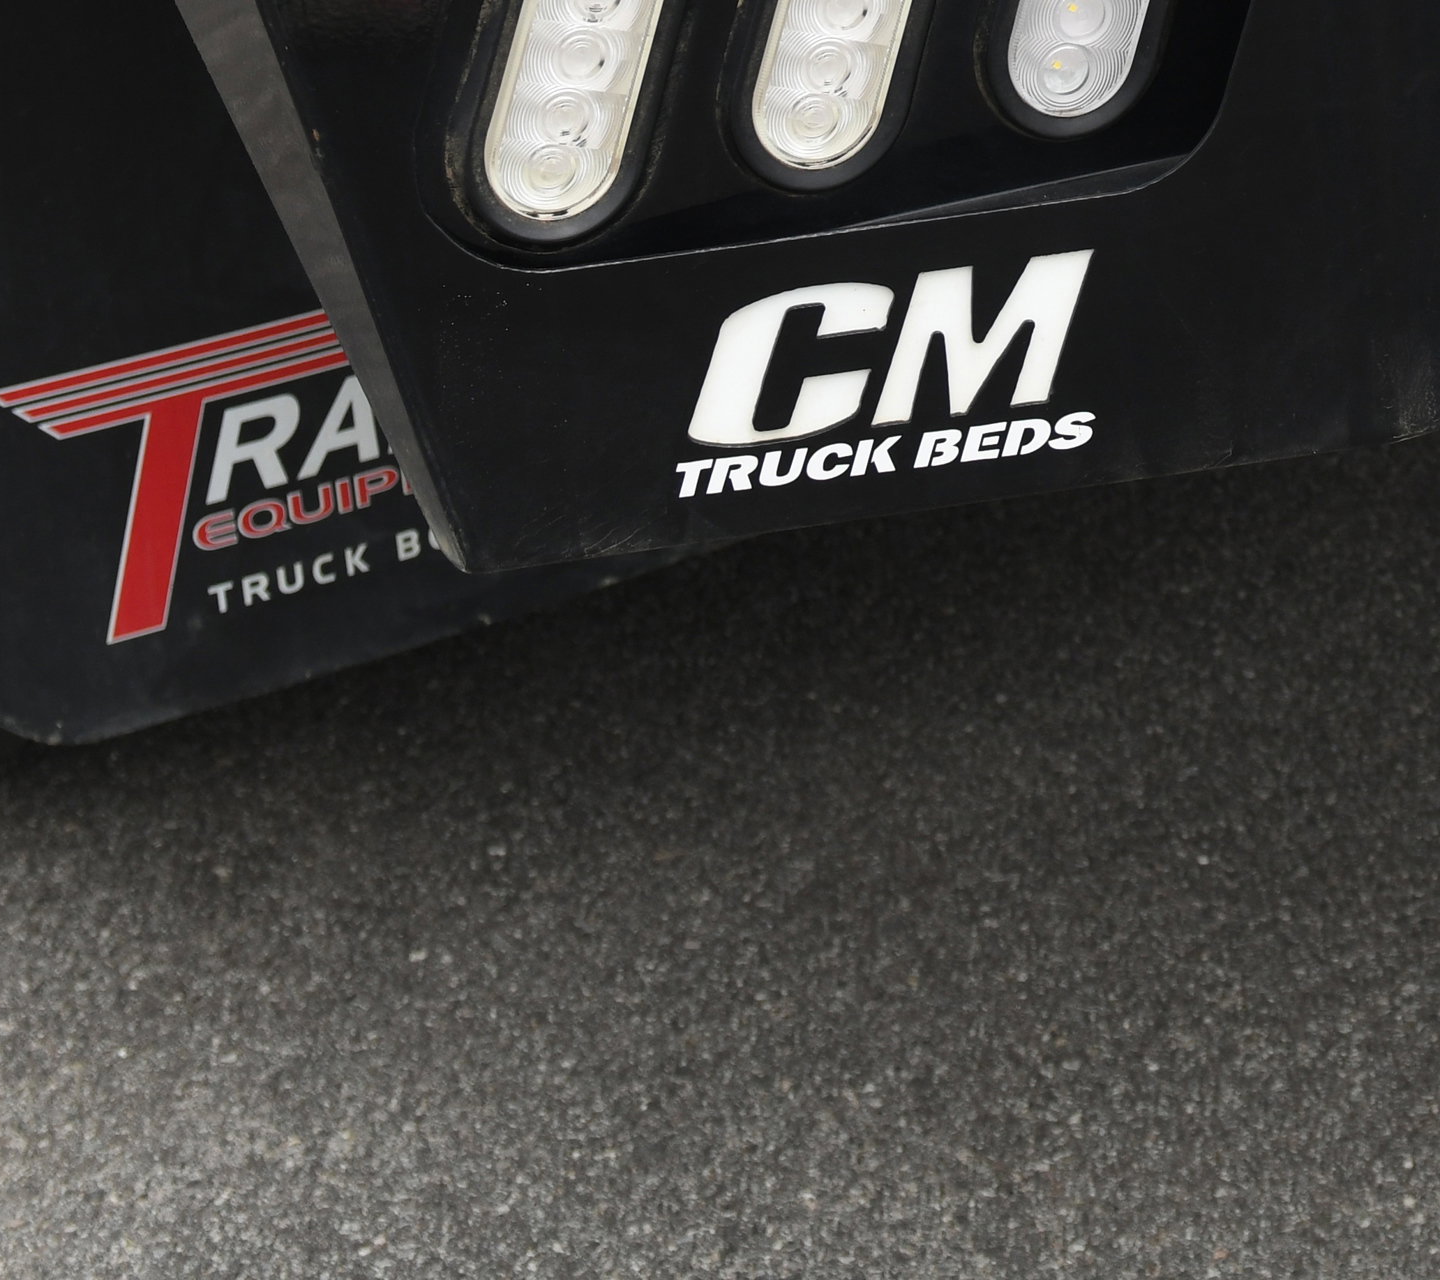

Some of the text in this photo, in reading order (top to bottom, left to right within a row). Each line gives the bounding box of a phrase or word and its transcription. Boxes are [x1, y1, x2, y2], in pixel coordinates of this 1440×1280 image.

[687, 247, 1095, 448] CM
[674, 410, 1097, 499] TRUCK BEDS
[192, 464, 415, 551] EQUIP
[207, 542, 370, 614] TRUCK
